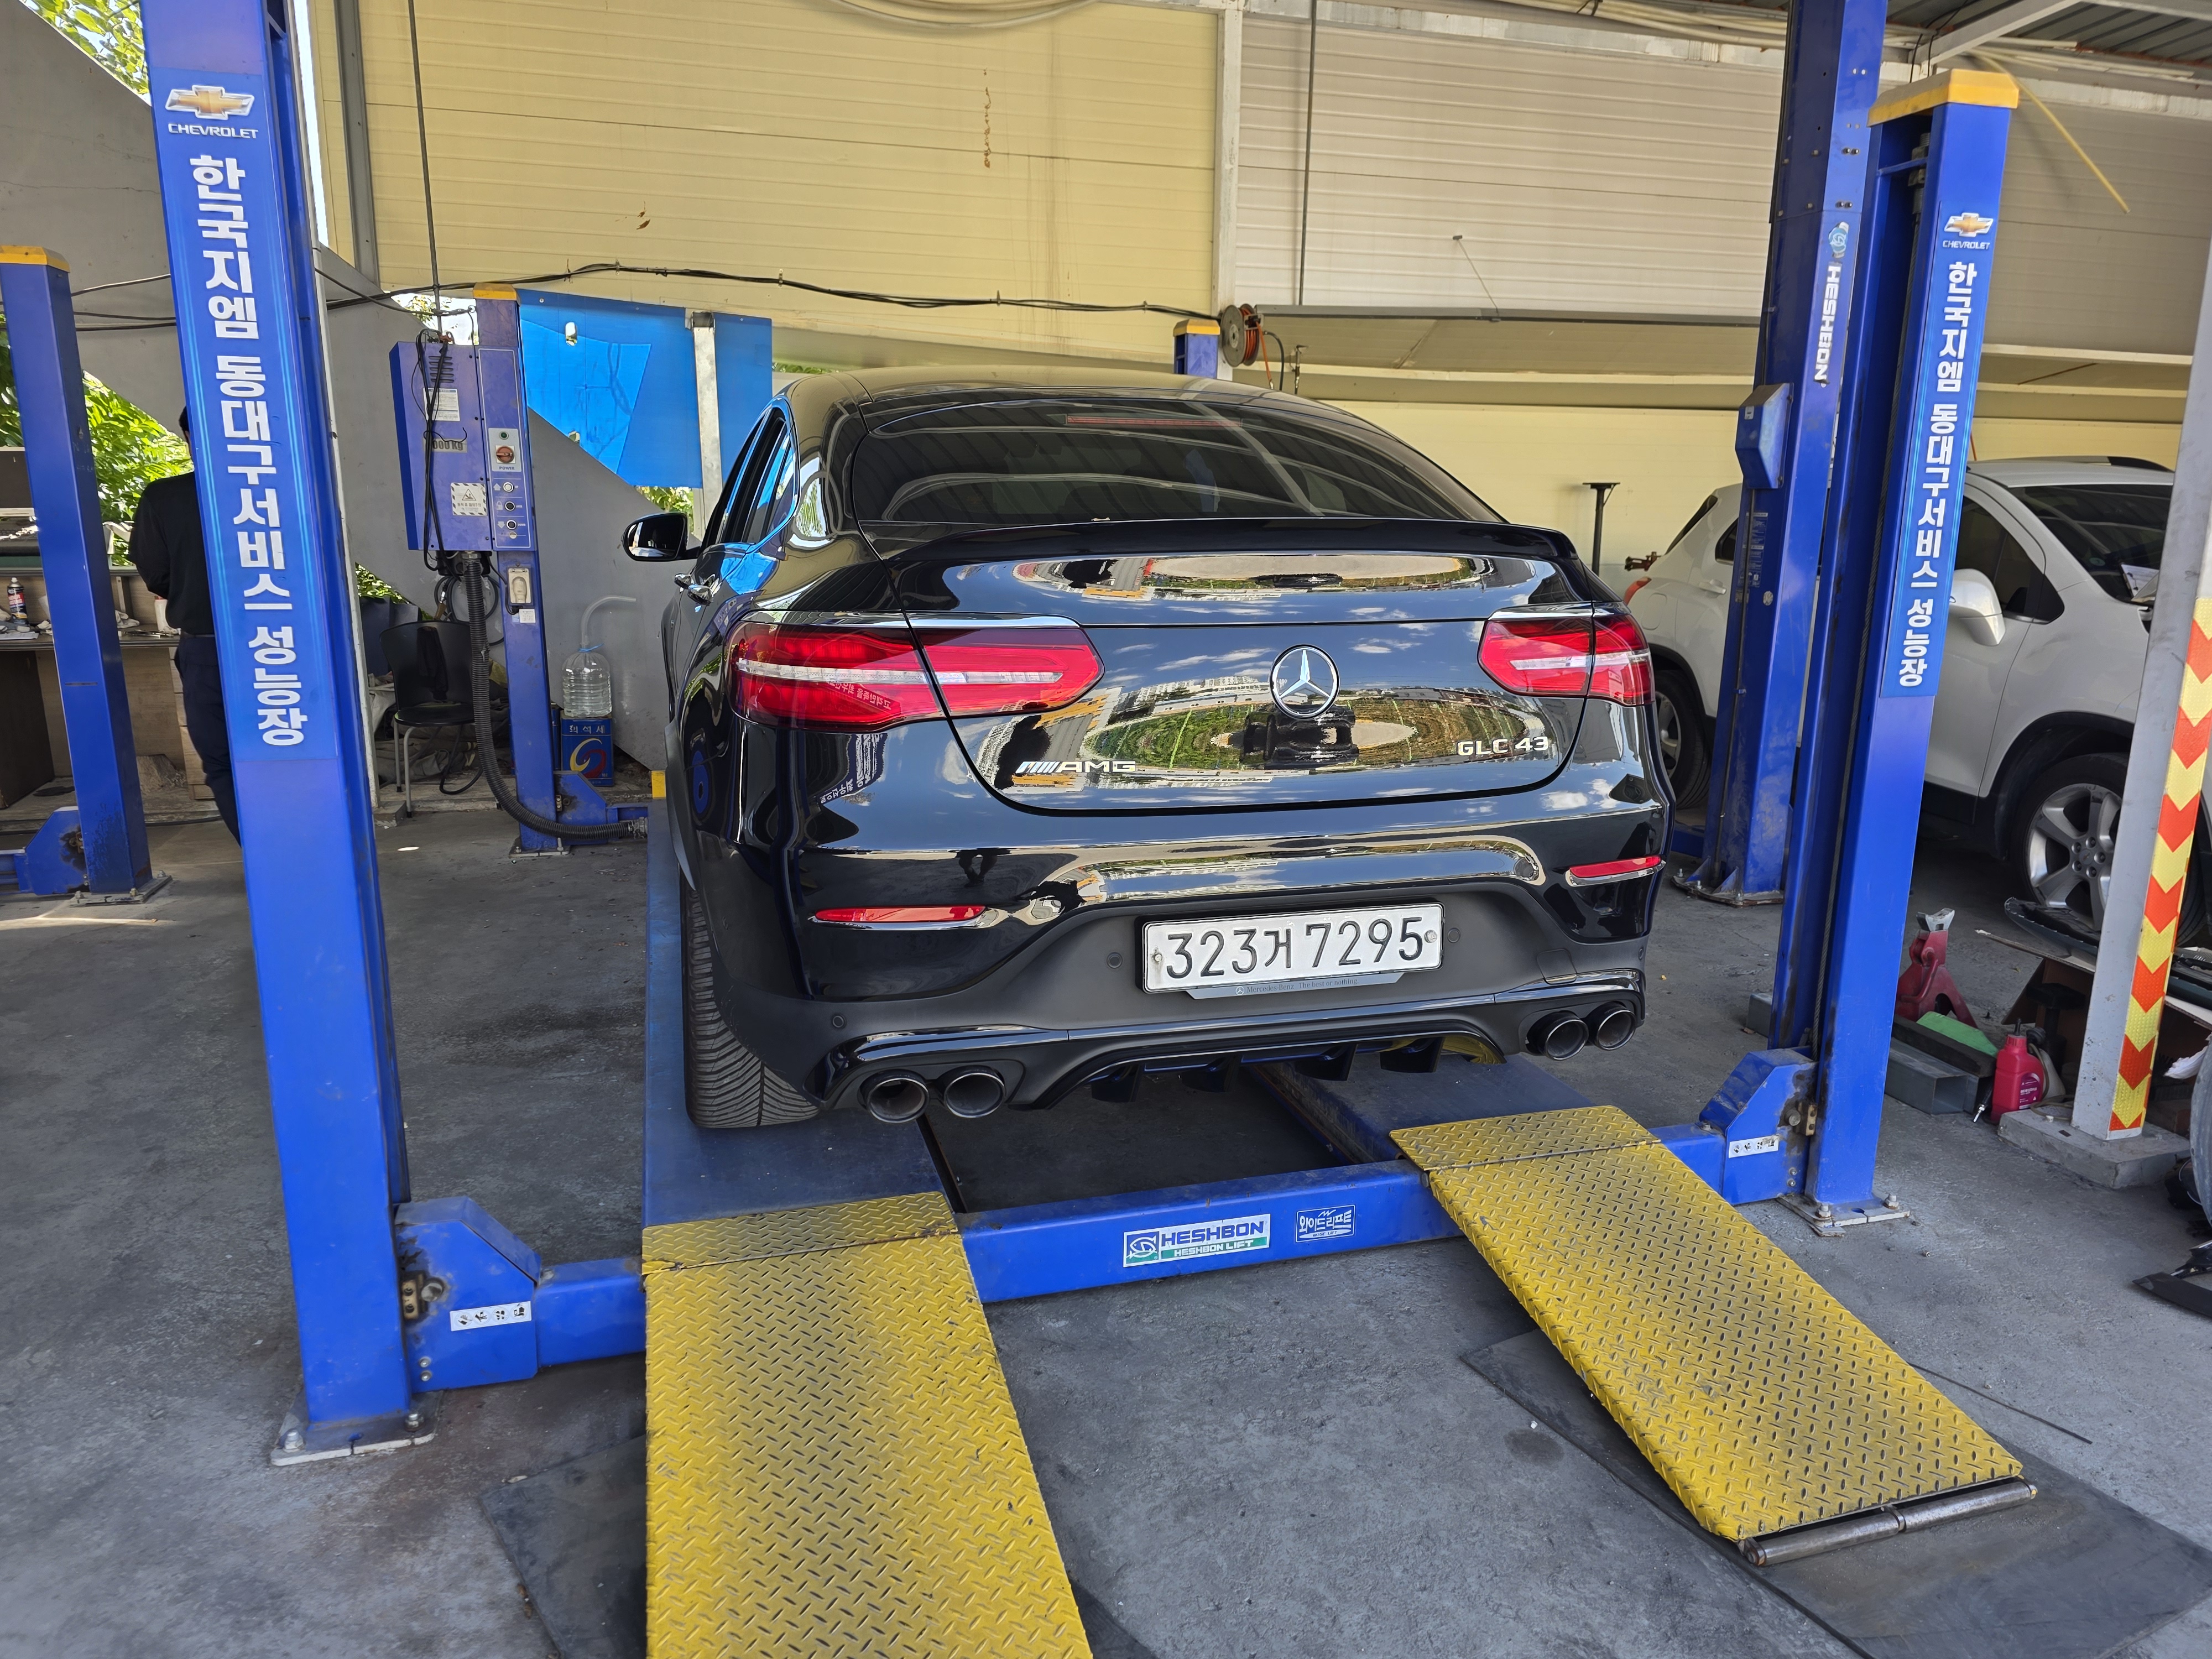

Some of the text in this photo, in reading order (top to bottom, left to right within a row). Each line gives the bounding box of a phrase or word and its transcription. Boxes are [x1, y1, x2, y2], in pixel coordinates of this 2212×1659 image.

[168, 123, 259, 139] CHEVROLET
[1942, 239, 1990, 250] CHEVROLET
[1814, 265, 1841, 382] HESHBON
[190, 154, 308, 746] 한국지엠 동대구서비스 성능장
[1899, 261, 1978, 687] 한국지엠 동대구서비스 성능장
[1457, 736, 1549, 756] GLC 43
[1053, 761, 1136, 773] AMG
[1166, 916, 1423, 979] 323거 7295
[1246, 984, 1295, 993] Mercedes-Benz
[1298, 1209, 1352, 1233] 와이드리프트
[1161, 1220, 1264, 1247] HESHBON
[1174, 1239, 1254, 1257] HESHBON LIFT
